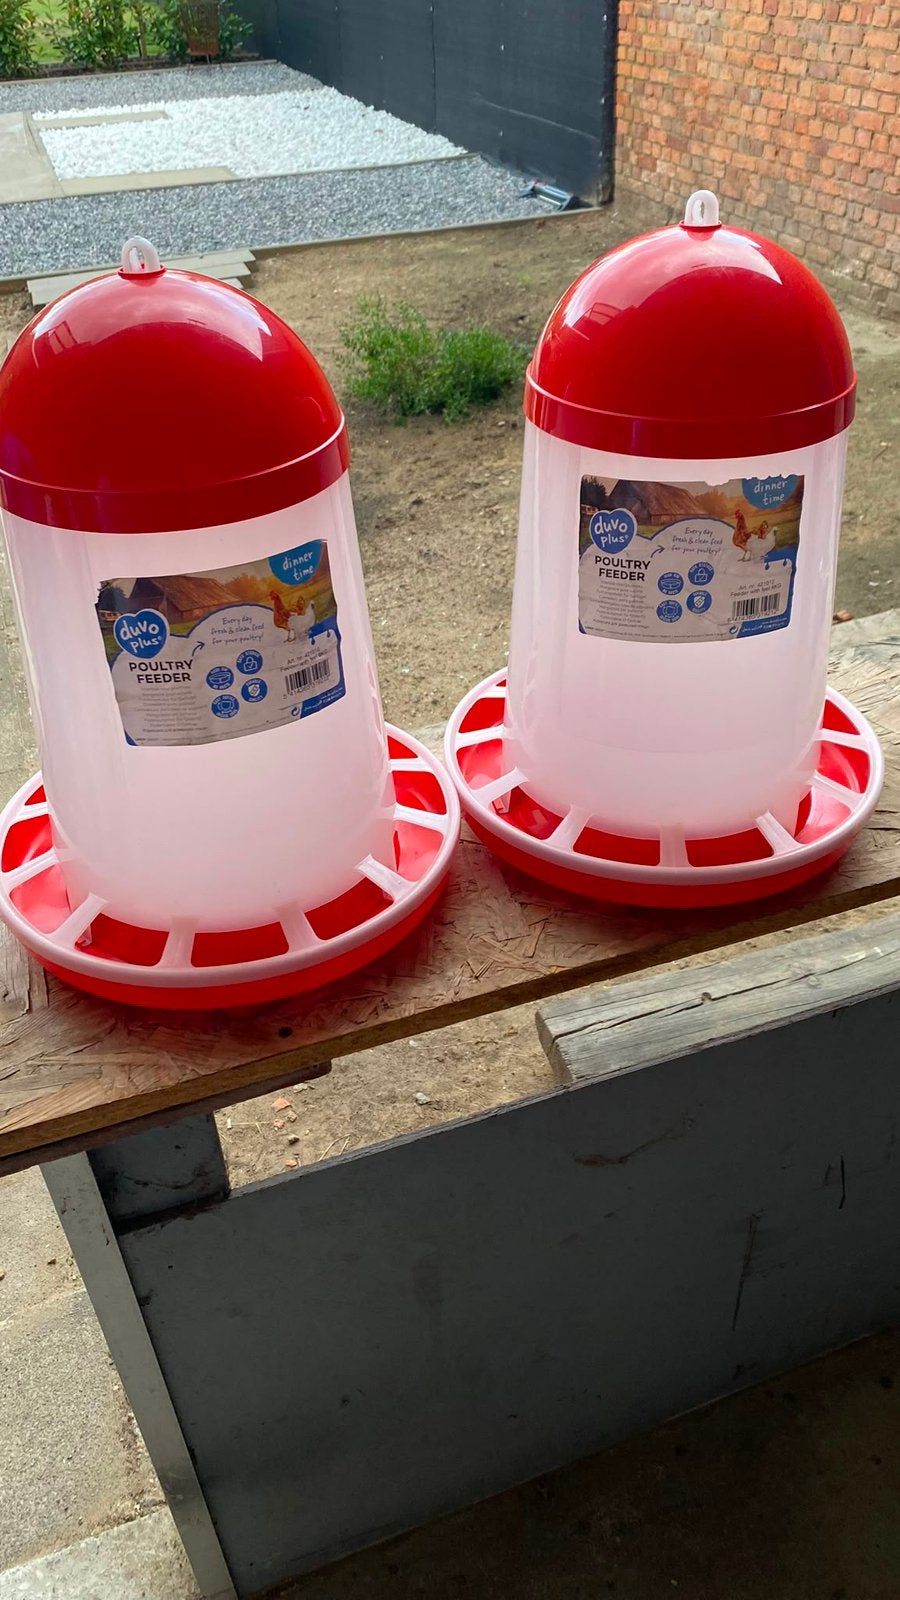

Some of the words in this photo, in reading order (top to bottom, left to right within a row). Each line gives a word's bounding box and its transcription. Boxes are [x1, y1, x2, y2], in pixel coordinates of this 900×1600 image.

[753, 479, 788, 494] dinner
[763, 492, 785, 505] time
[594, 515, 628, 535] duvo
[688, 536, 694, 545] &
[282, 551, 313, 570] dinner
[594, 555, 651, 570] POULTRY
[293, 565, 315, 580] time
[598, 567, 646, 582] FEEDER
[120, 619, 160, 640] duvo
[128, 659, 193, 672] POULTRY
[136, 672, 192, 684] FEEDER
